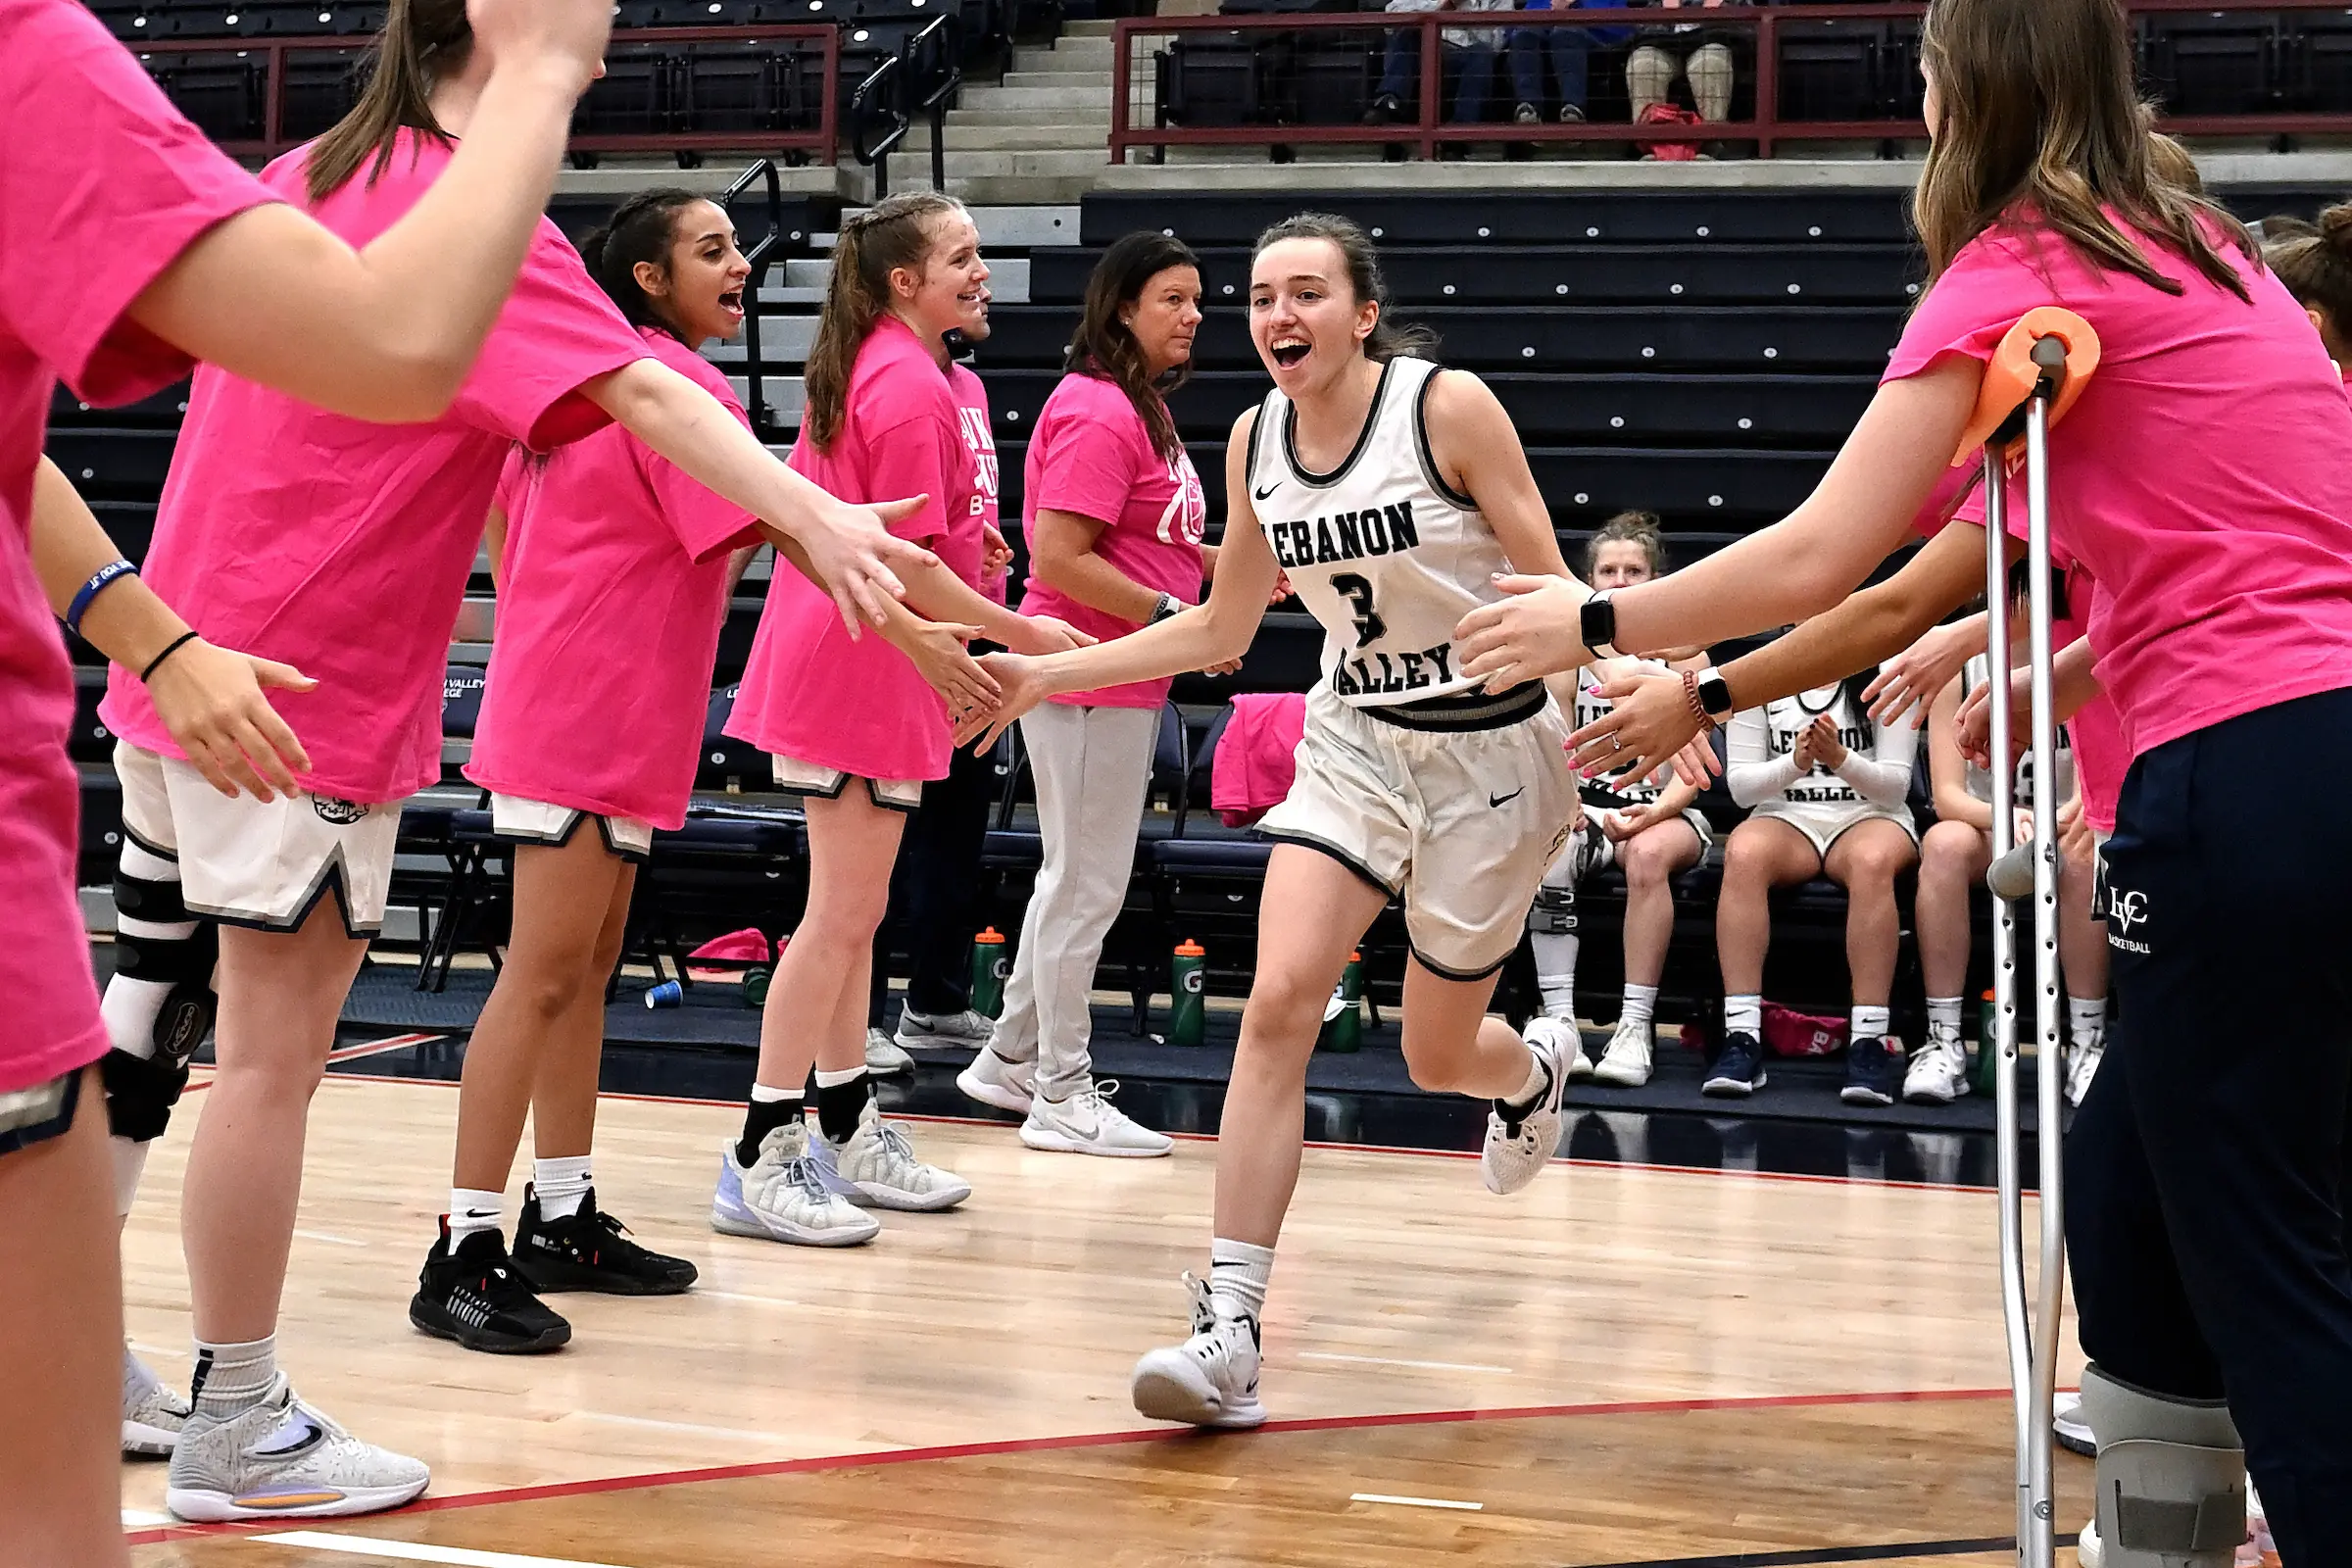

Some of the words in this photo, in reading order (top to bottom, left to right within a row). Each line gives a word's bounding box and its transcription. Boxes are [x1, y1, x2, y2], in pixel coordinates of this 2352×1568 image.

[1260, 500, 1420, 568] EBANON
[1329, 571, 1388, 650] 3
[1333, 642, 1452, 696] ALLEY
[1769, 727, 1875, 756] LEON
[1183, 970, 1203, 993] G
